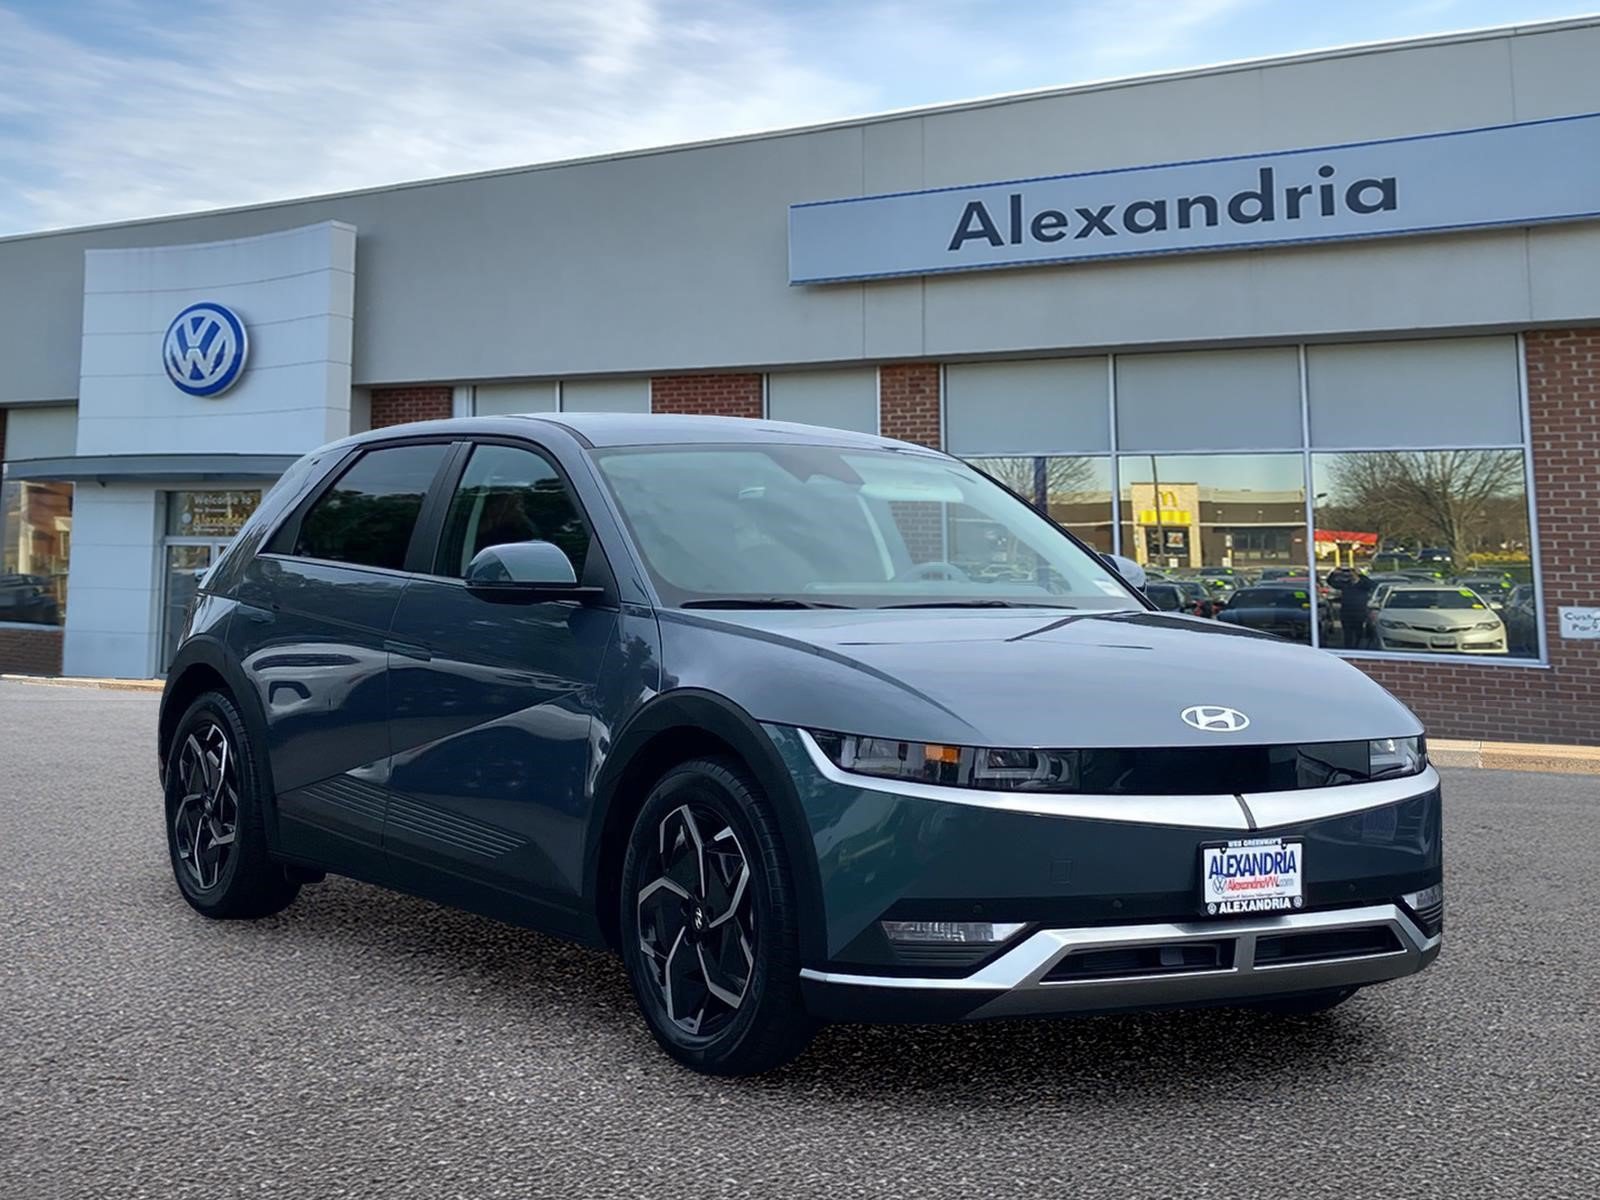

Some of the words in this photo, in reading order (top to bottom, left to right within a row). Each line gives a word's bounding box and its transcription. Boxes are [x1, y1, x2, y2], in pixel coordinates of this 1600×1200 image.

[948, 165, 1397, 250] Alexandria
[1209, 850, 1297, 878] ALEXANDRIA
[1219, 898, 1291, 914] ALEXANDRIA
